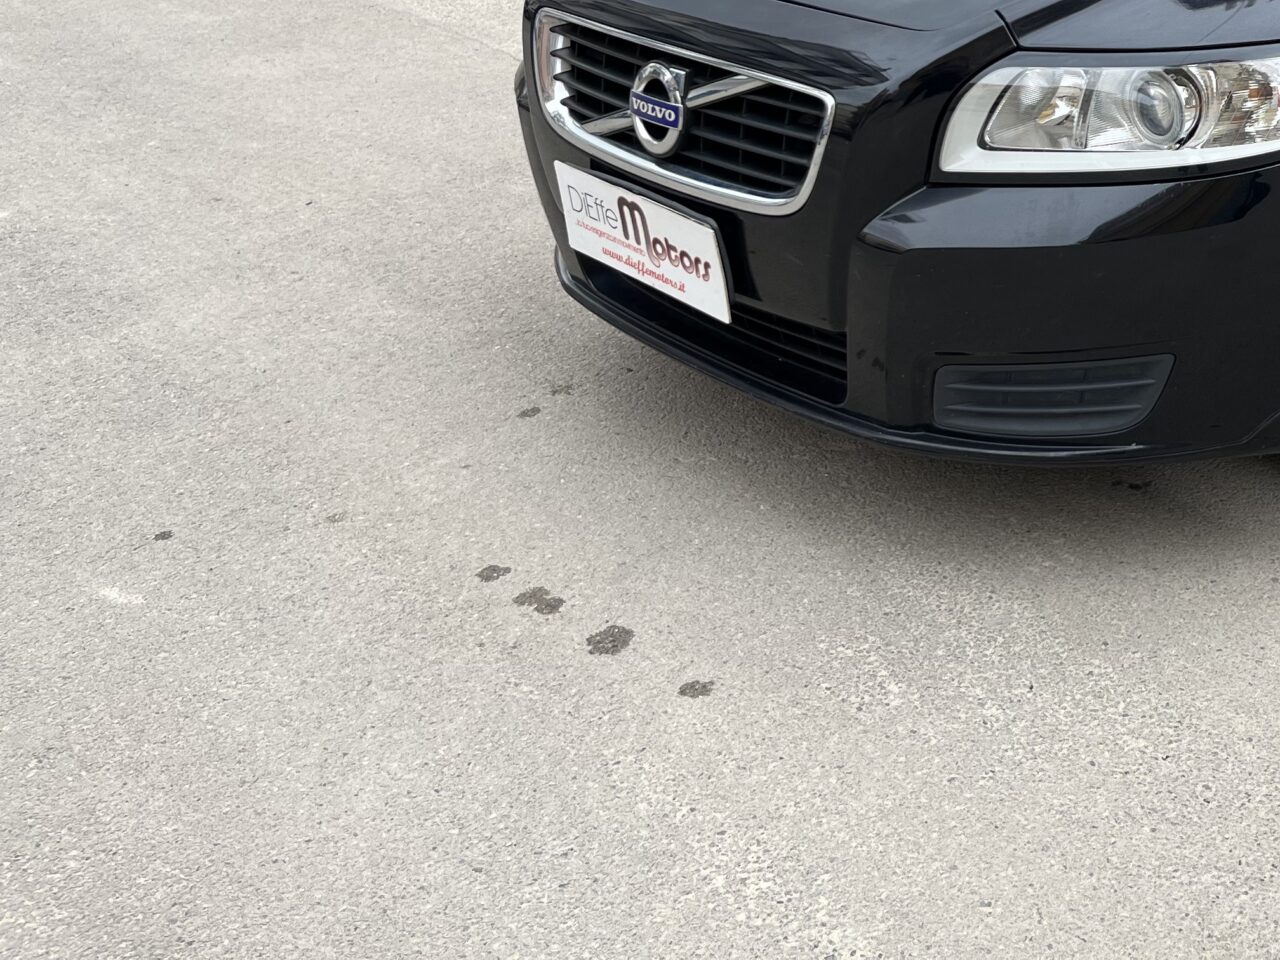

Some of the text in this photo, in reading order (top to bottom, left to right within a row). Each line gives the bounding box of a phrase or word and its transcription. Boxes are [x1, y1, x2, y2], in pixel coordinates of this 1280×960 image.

[631, 96, 676, 122] VOLVO
[568, 185, 619, 230] DiEffe
[602, 247, 686, 294] www.dieffemotors.it
